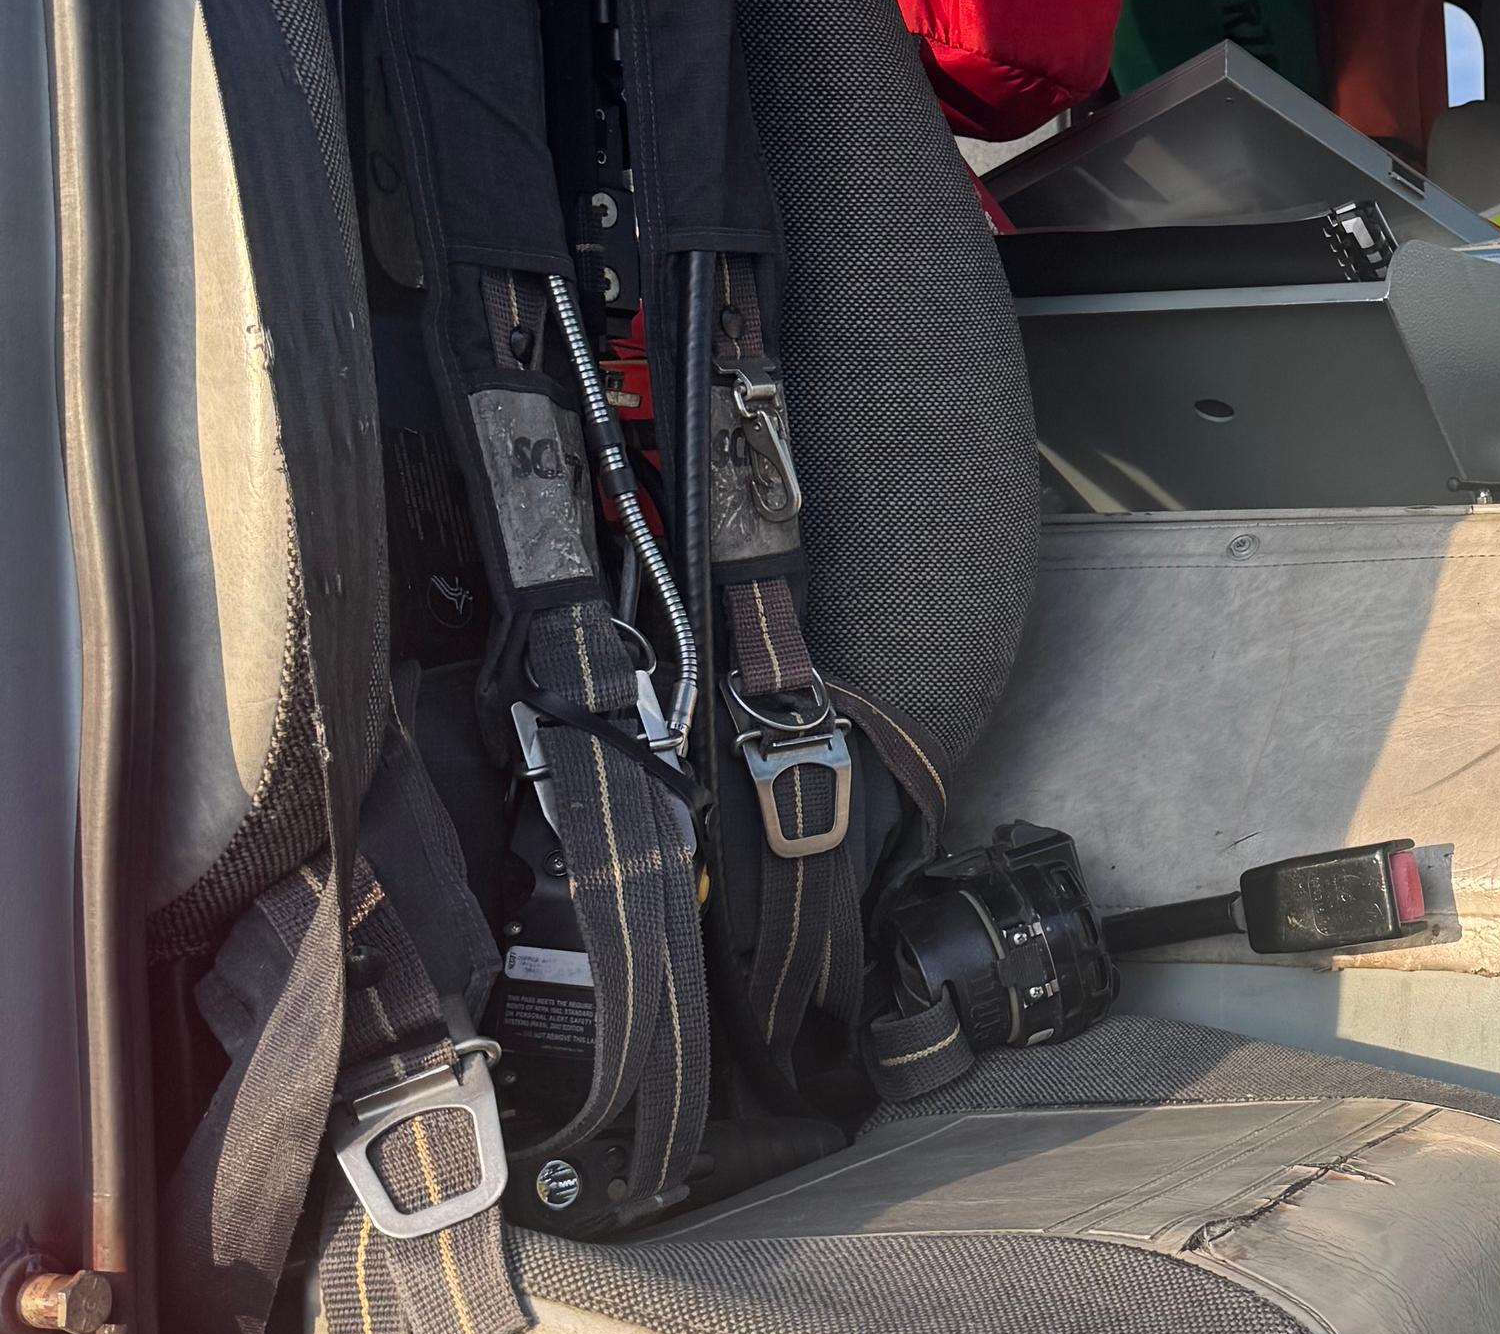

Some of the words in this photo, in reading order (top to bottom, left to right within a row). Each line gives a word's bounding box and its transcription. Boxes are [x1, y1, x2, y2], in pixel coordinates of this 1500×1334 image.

[537, 998, 556, 1006] MEETS
[564, 1008, 593, 1017] STANDARD
[515, 1012, 547, 1021] PERSONAL
[549, 1015, 568, 1023] ALERT
[570, 1017, 592, 1025] SAFETY
[546, 1034, 571, 1042] REMOVE
